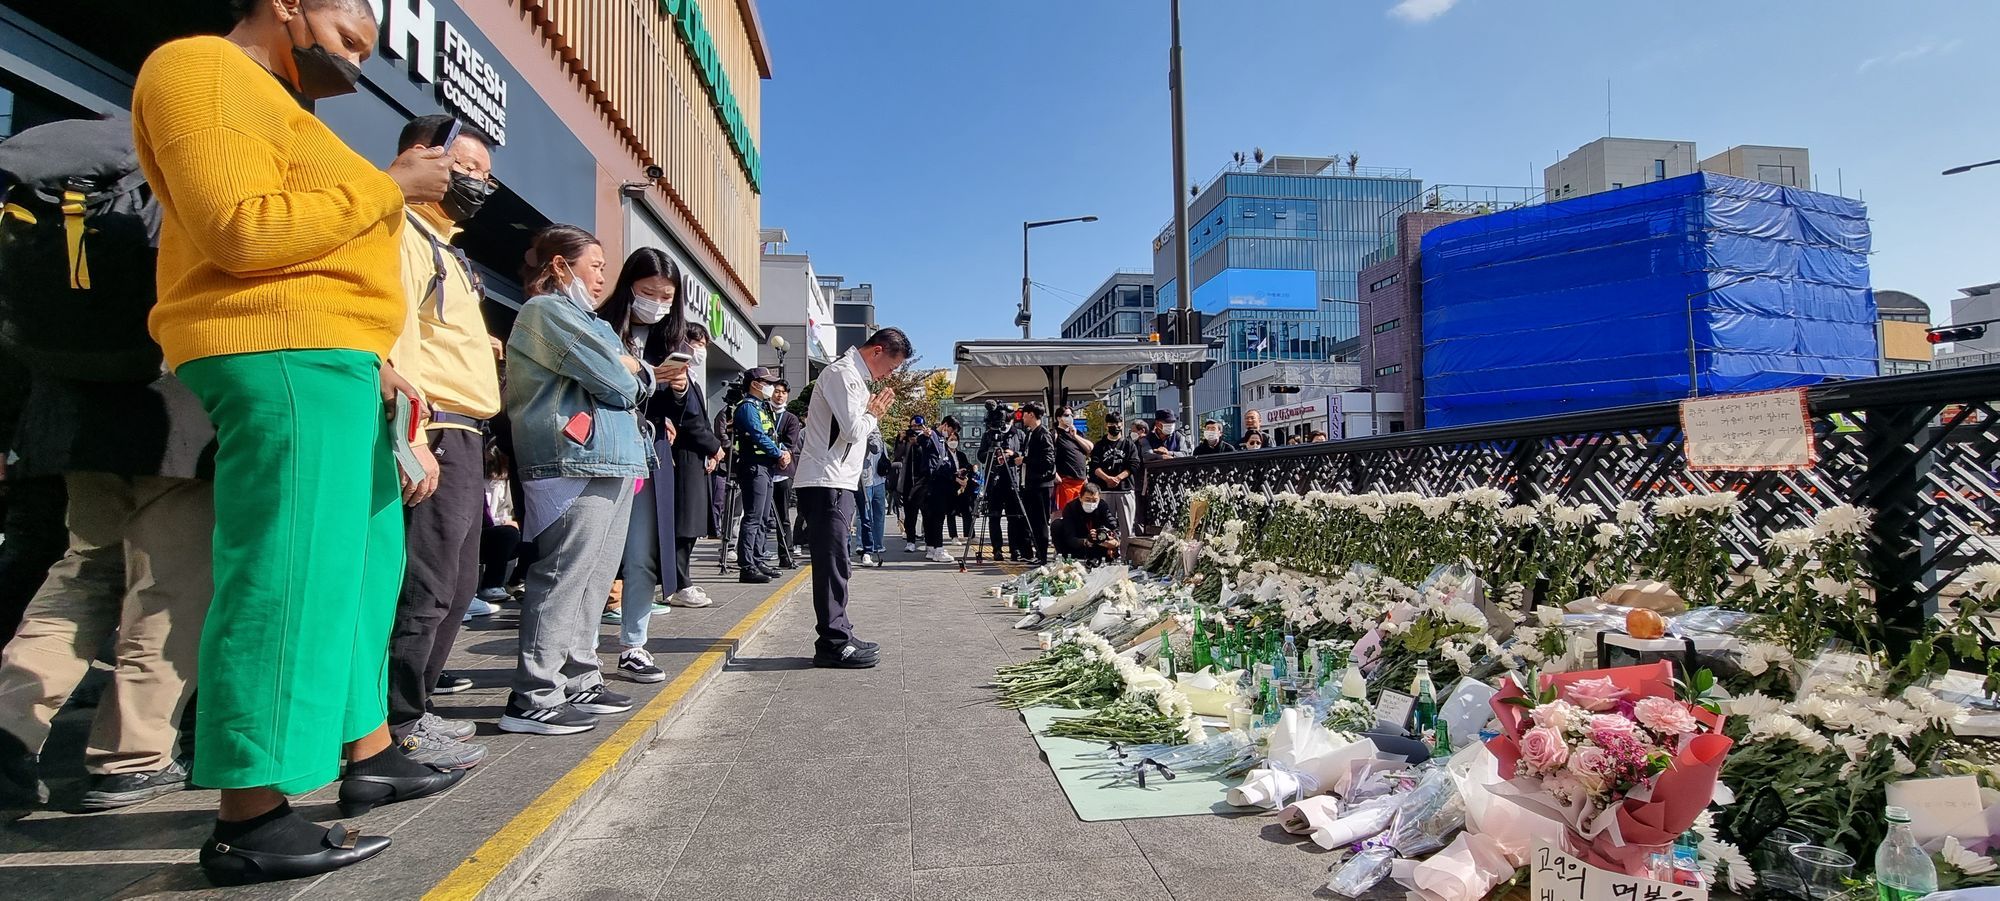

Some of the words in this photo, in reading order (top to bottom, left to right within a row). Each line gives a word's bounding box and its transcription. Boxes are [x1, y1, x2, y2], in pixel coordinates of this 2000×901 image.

[443, 20, 507, 109] FRESH
[443, 56, 506, 128] HANDMADE
[443, 80, 506, 147] COSMETICS
[687, 274, 713, 321] OLIVE
[1331, 396, 1340, 439] TRANS
[1538, 847, 1587, 900] 고인의
